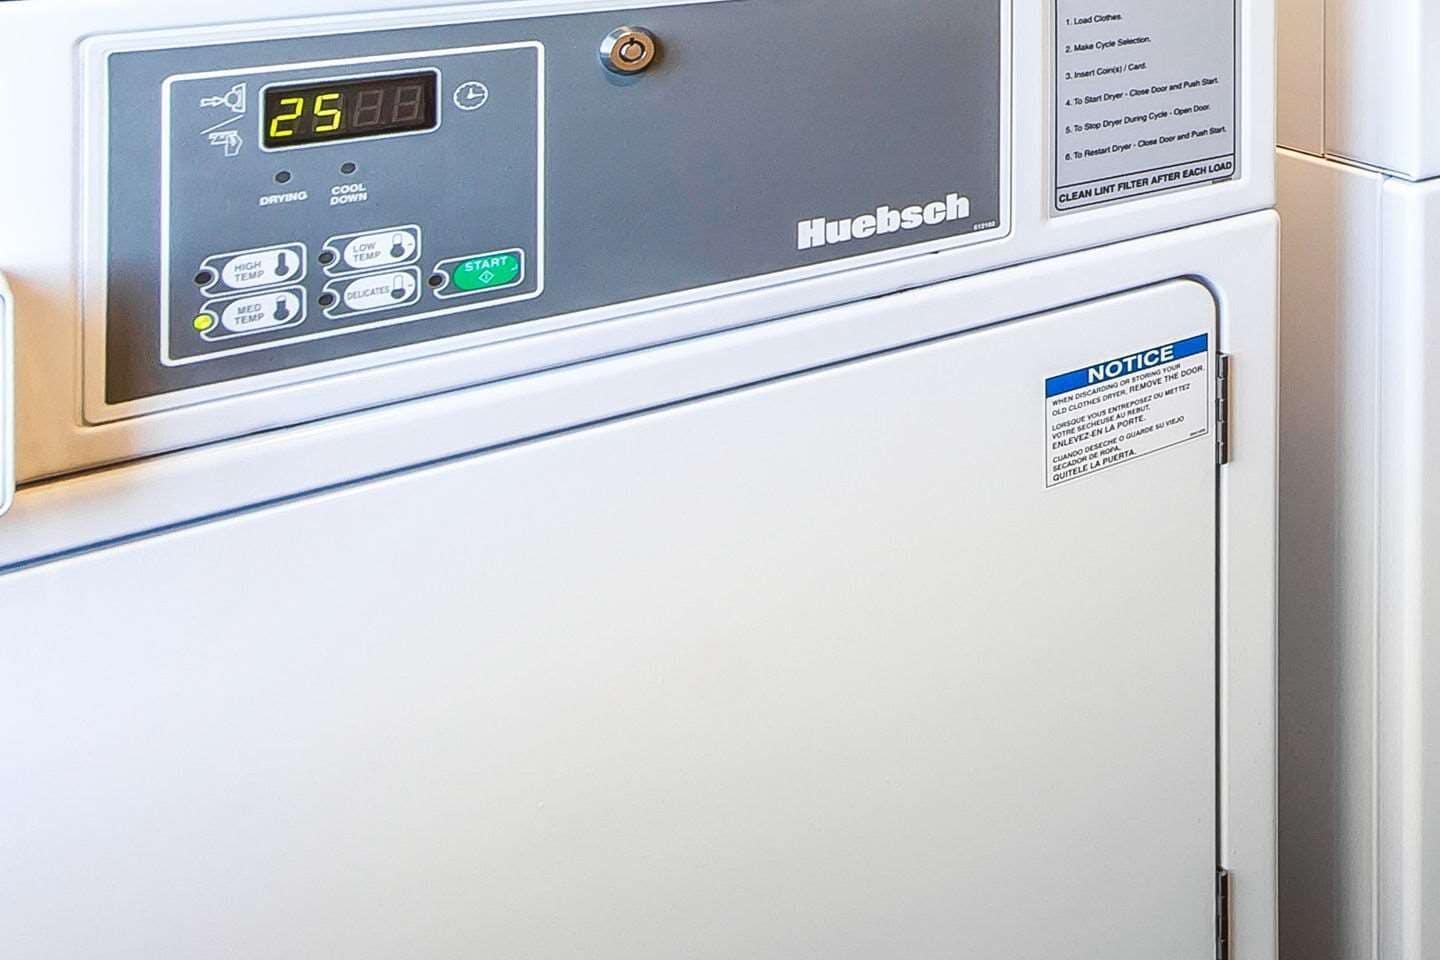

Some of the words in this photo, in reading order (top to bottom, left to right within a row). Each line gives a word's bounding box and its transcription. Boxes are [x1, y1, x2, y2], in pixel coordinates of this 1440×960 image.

[1074, 16, 1092, 25] Load
[1065, 45, 1073, 53] 2.
[1074, 43, 1094, 51] Make
[1095, 40, 1116, 50] Cycle
[1117, 36, 1151, 46] Selection.
[1065, 72, 1073, 80] 3.
[1074, 69, 1095, 78] Insert
[1084, 95, 1102, 104] Start
[1103, 93, 1123, 101] Dryer
[1129, 88, 1149, 97] Close
[1151, 85, 1168, 94] Door
[1169, 82, 1182, 91] and
[1183, 80, 1200, 89] Push
[269, 93, 342, 137] 25
[1065, 126, 1073, 134] 5.
[1074, 124, 1083, 132] To
[1084, 122, 1101, 131] Stop
[1103, 119, 1122, 128] Dryer
[1124, 115, 1147, 124] During
[1148, 111, 1168, 120] Cycle
[1173, 107, 1192, 115] Open
[1193, 104, 1211, 112] Door.
[1073, 151, 1083, 159] To
[1084, 146, 1111, 157] Restart
[1112, 144, 1132, 152] Dryer
[1137, 139, 1157, 147] Close
[1159, 135, 1176, 143] Door
[1177, 132, 1190, 140] and
[1191, 129, 1208, 138] Push
[1209, 126, 1227, 135] Start.
[331, 183, 367, 195] COOL
[1058, 187, 1093, 203] CLEAN
[1094, 183, 1116, 196] LINT
[1117, 178, 1149, 193] FILTER
[1150, 172, 1181, 185] AFTER
[1182, 166, 1206, 179] EACH
[1208, 161, 1232, 173] LOAD
[259, 191, 308, 206] DRYING
[330, 192, 368, 206] DOWN
[797, 193, 969, 249] Huebsch
[352, 242, 376, 253] LOW
[353, 250, 381, 263] TEMP
[234, 261, 262, 273] HIGH
[465, 256, 507, 272] START
[234, 271, 264, 283] TEMP
[346, 285, 390, 300] DELICATES
[234, 313, 264, 325] TEMP
[237, 303, 262, 315] MED
[1088, 345, 1174, 384] NOTICE
[1052, 395, 1073, 406] WHEN
[1075, 383, 1118, 399] DISCARDING
[1120, 379, 1130, 387] OR
[1132, 369, 1161, 383] STORING
[1163, 363, 1181, 373] YOUR
[1052, 407, 1067, 416] OLD
[1068, 398, 1101, 412] CLOTHES
[1129, 378, 1162, 393] REMOVE
[1165, 372, 1179, 383] THE
[1181, 365, 1205, 377] DOOR.
[1052, 416, 1085, 431] LORSQUE
[1087, 409, 1106, 419] VOUS
[1108, 395, 1152, 414] ENTREPOSEZ
[1153, 392, 1163, 400] OU
[1165, 383, 1191, 396] METTEZ
[1052, 428, 1075, 439] VOTRE
[1077, 415, 1115, 432] SECHEUSE
[1116, 411, 1126, 419] AU
[1052, 427, 1103, 450] ENLEVEZ-EN
[1104, 424, 1115, 433] LA
[1117, 414, 1146, 429] PORTE.
[1053, 448, 1083, 463] CUANDO
[1084, 437, 1117, 453] DESECHE
[1126, 425, 1154, 440] GUARDE
[1155, 422, 1165, 430] SU
[1166, 415, 1185, 427] VIEJO
[1053, 455, 1087, 472] SECADOR
[1088, 451, 1098, 460] DE
[1053, 463, 1088, 481] QUITELE
[1090, 460, 1101, 469] LA
[1102, 448, 1136, 465] PUERTA.
